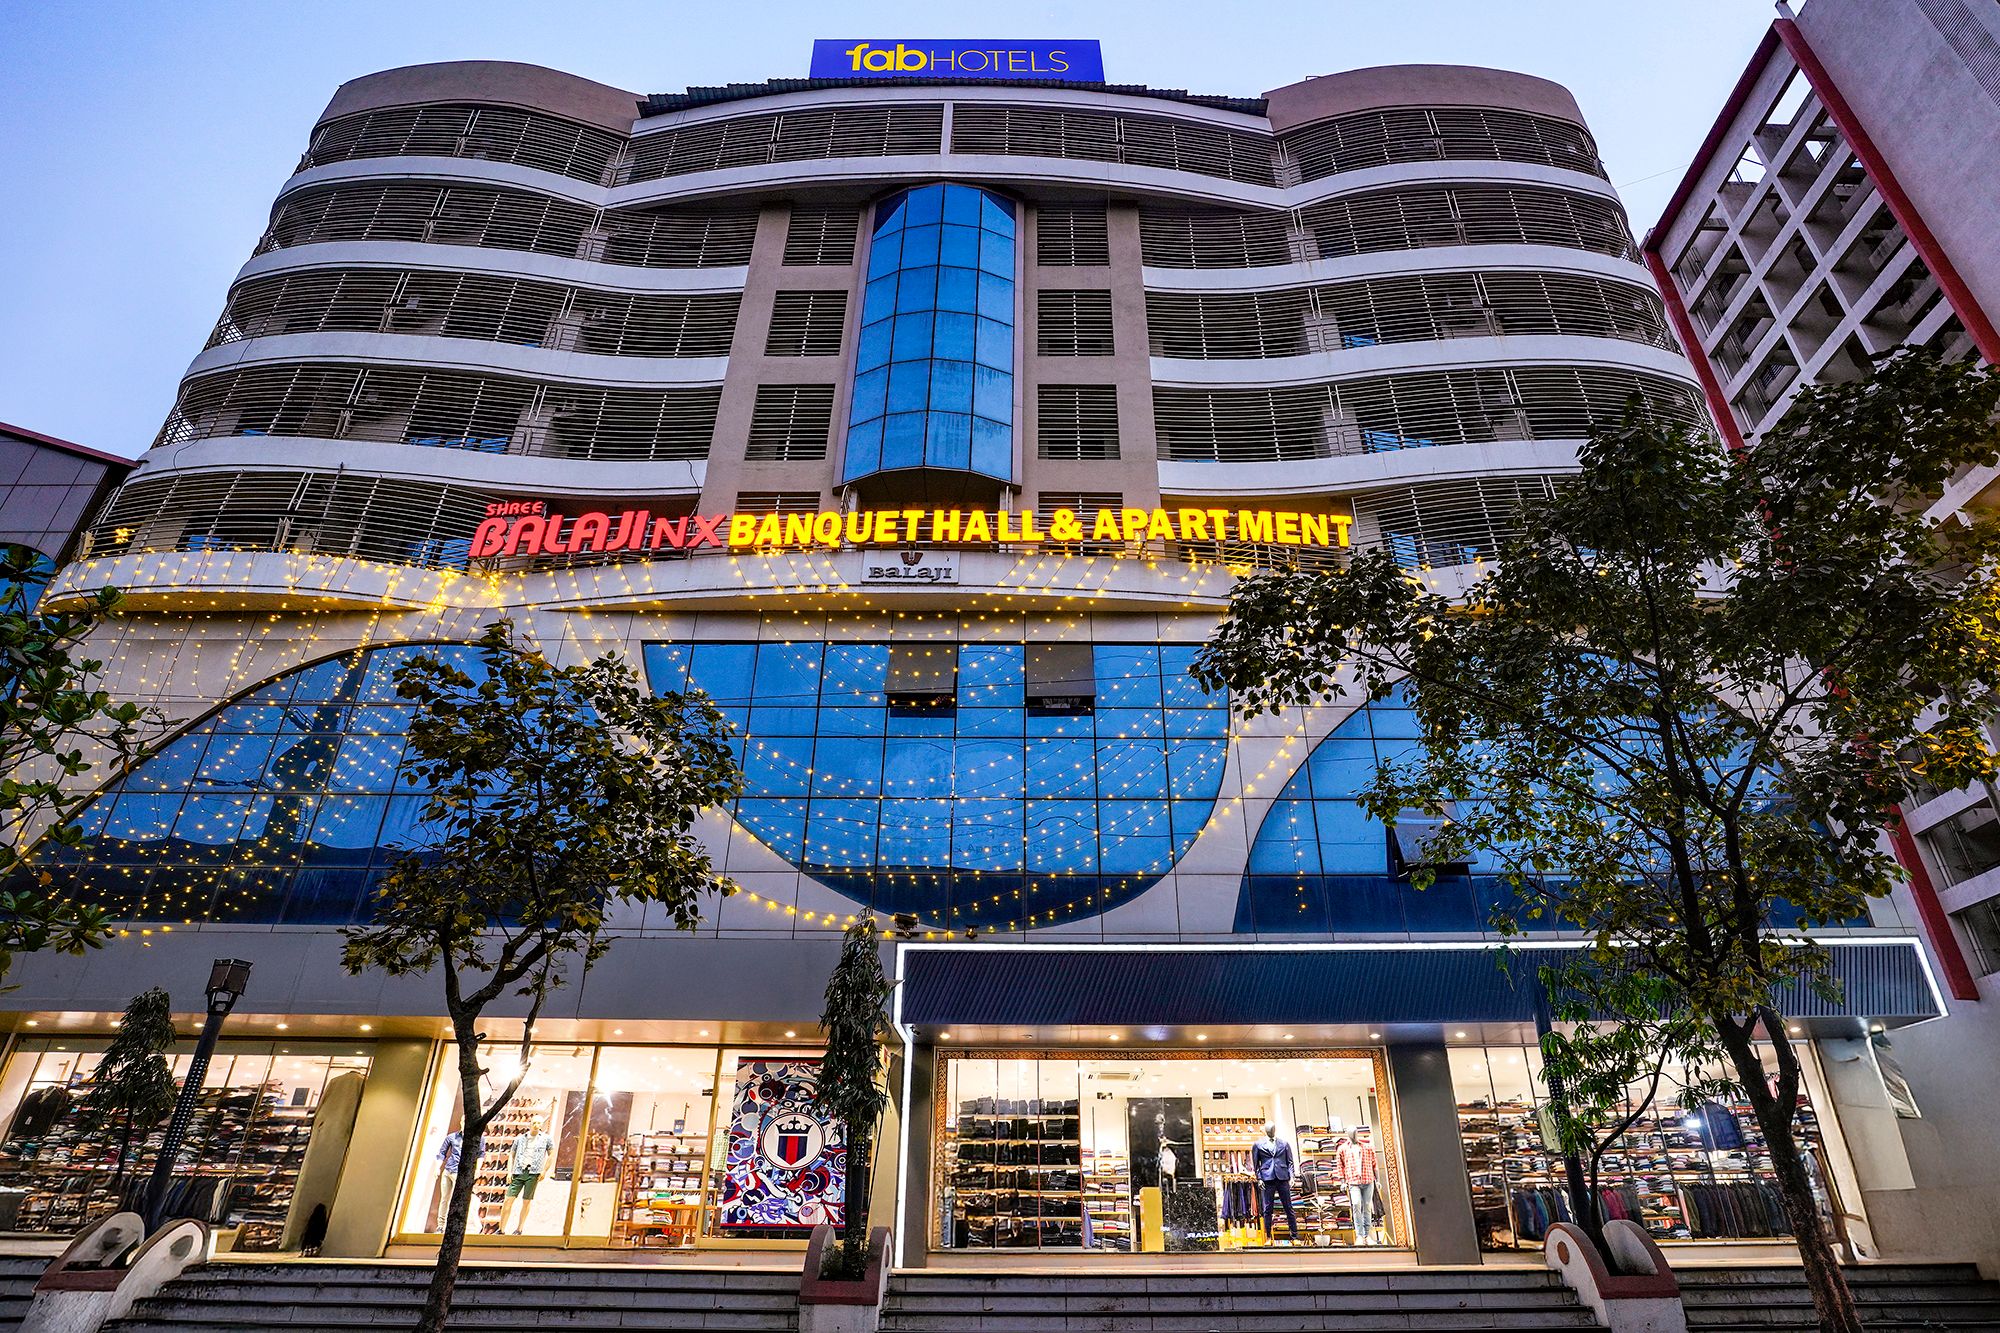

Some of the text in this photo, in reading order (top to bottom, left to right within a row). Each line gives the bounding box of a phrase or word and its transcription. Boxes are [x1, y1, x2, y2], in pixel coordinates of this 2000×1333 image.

[485, 501, 545, 516] SHREE
[468, 510, 650, 557] BALAJI
[728, 510, 925, 547] BANQUET
[932, 509, 1045, 542] HALL
[1050, 508, 1083, 541] &
